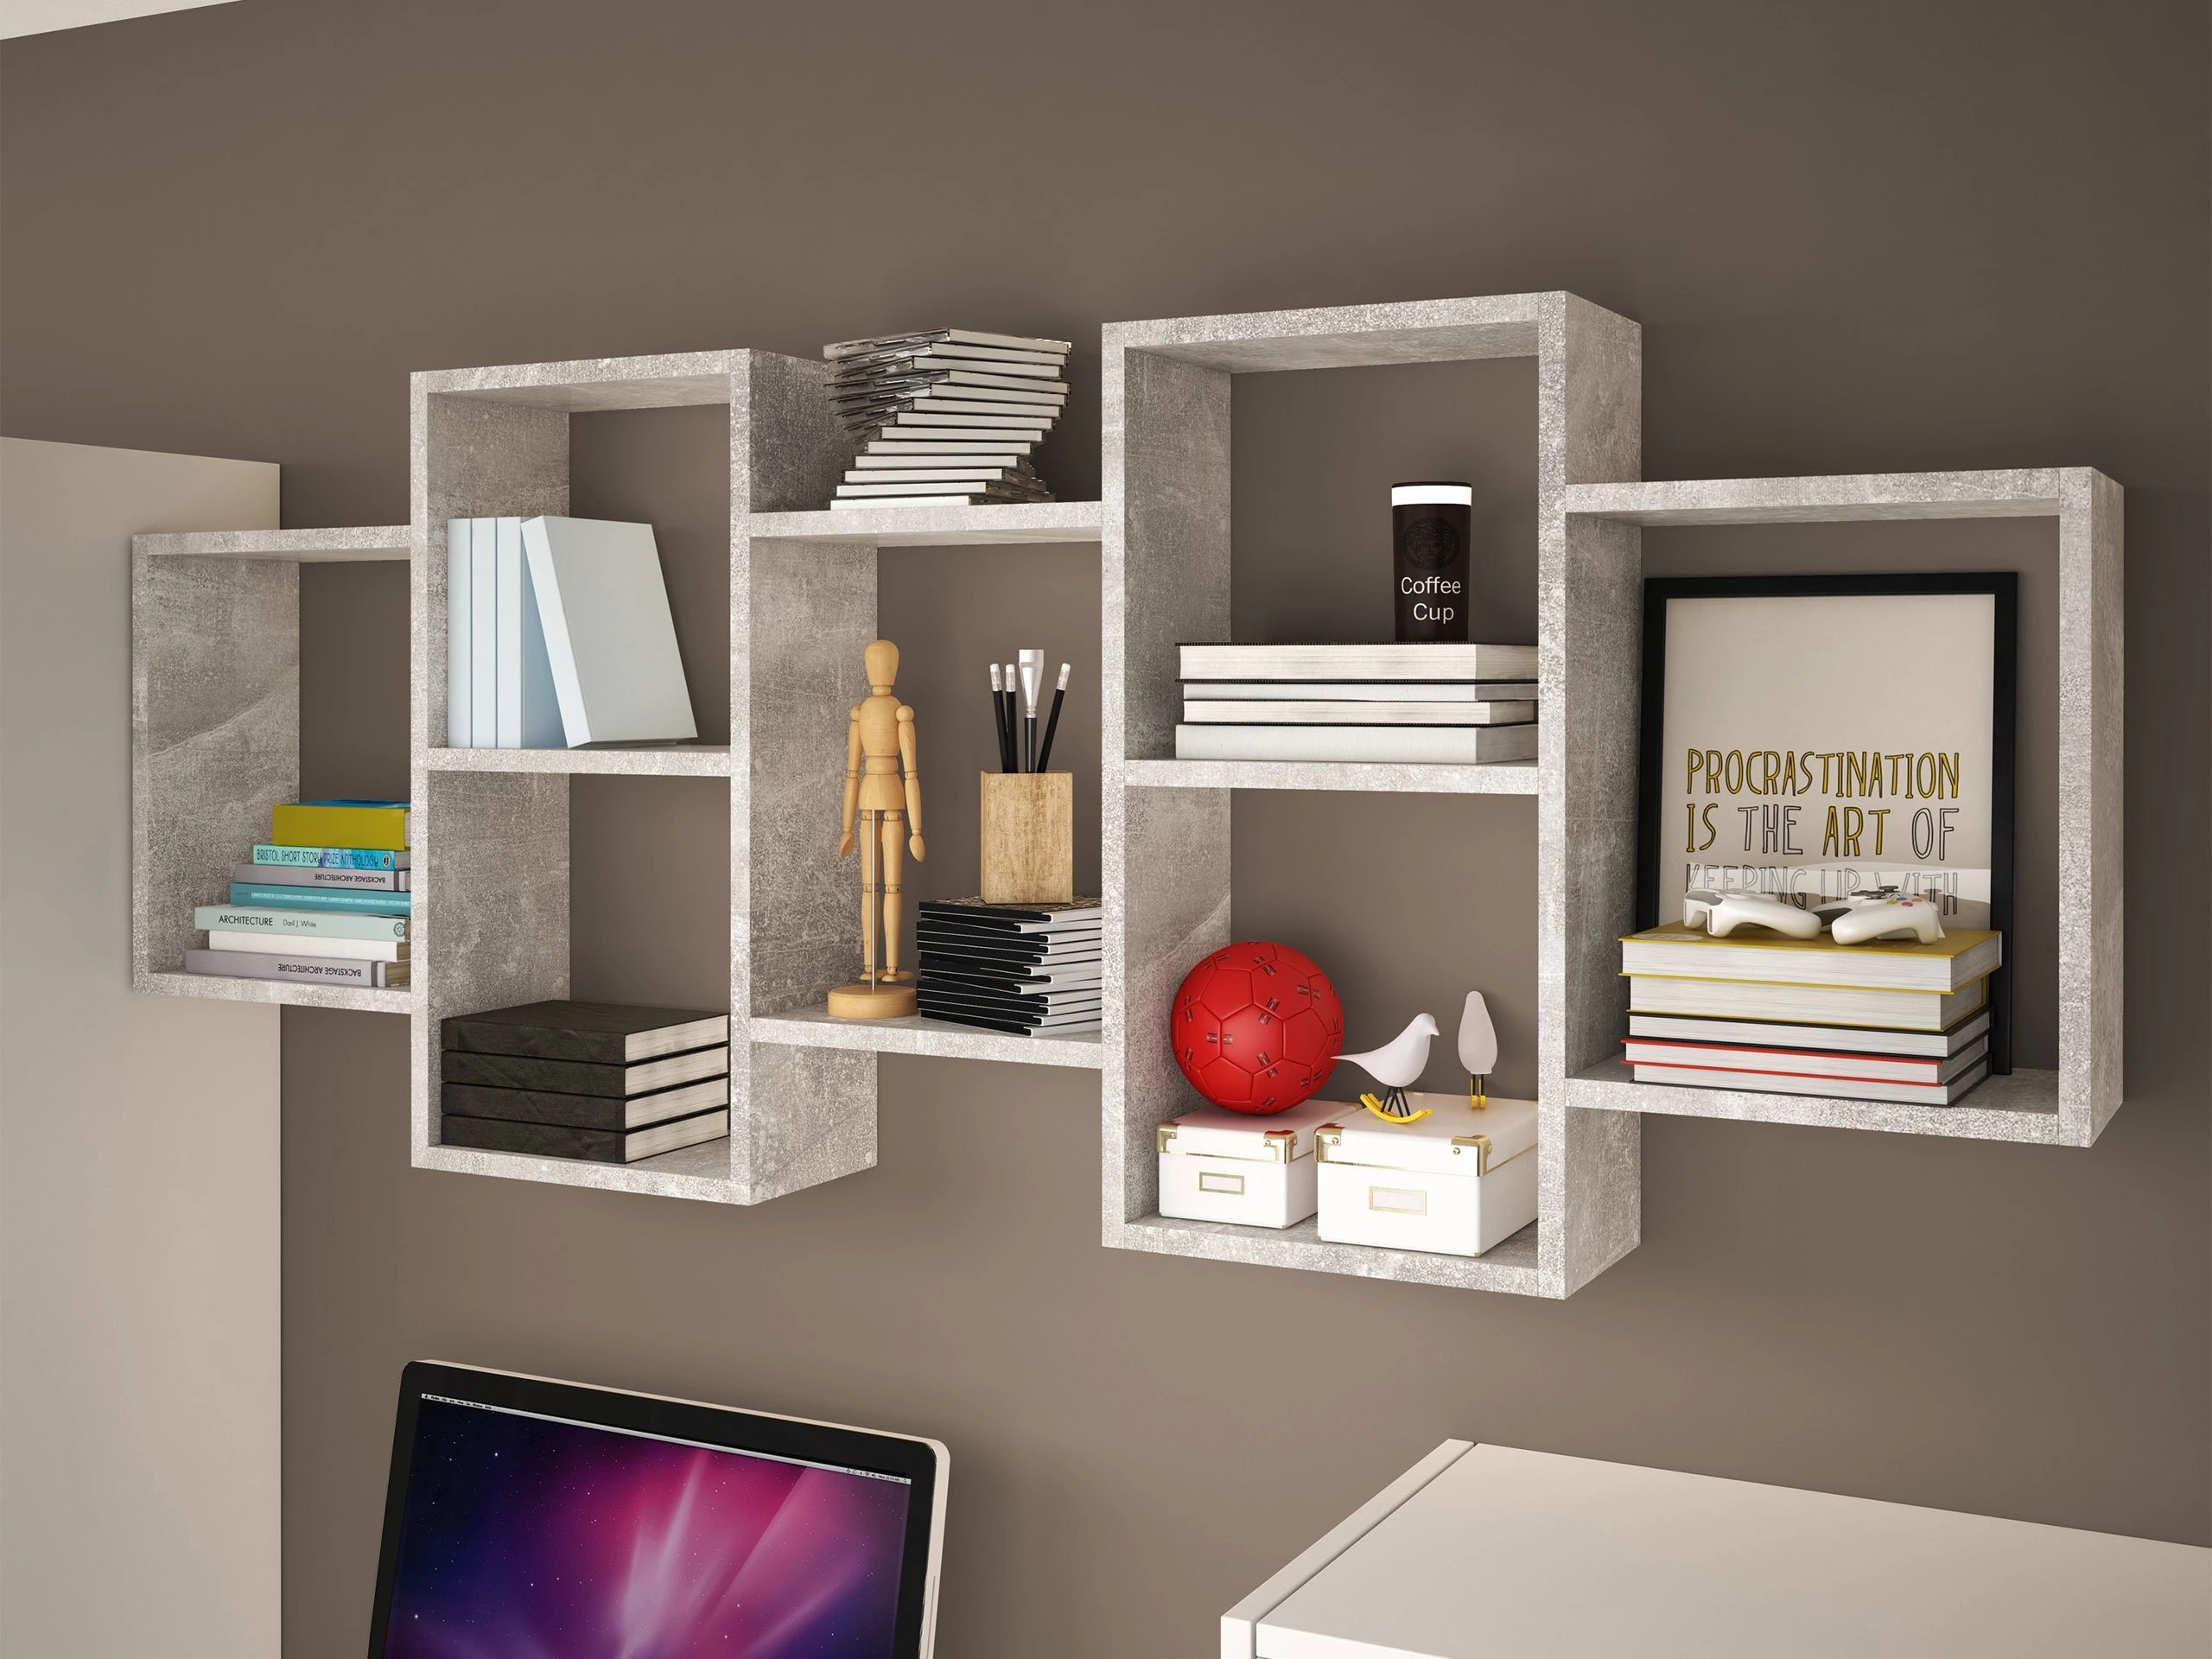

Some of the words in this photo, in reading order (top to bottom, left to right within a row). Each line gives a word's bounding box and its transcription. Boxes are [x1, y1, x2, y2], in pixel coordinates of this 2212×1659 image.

[1401, 576, 1461, 594] Coffee
[1413, 602, 1455, 625] Cup
[1687, 748, 1960, 800] PROCRASTINATION
[1686, 803, 1719, 853] IS
[1738, 804, 1803, 855] THE
[1822, 805, 1891, 857] ART
[1911, 807, 1960, 861] OF
[257, 849, 279, 861] BRISTOL
[282, 849, 301, 862] SHORT
[323, 852, 339, 865] PRIZE
[315, 873, 353, 882] ARCHITECTURE
[354, 875, 386, 884] BACKSTAGE
[219, 915, 273, 926] ARCHITECTURE
[278, 963, 324, 975] ARCHITECTURE
[325, 967, 361, 977] BACKSTAGE
